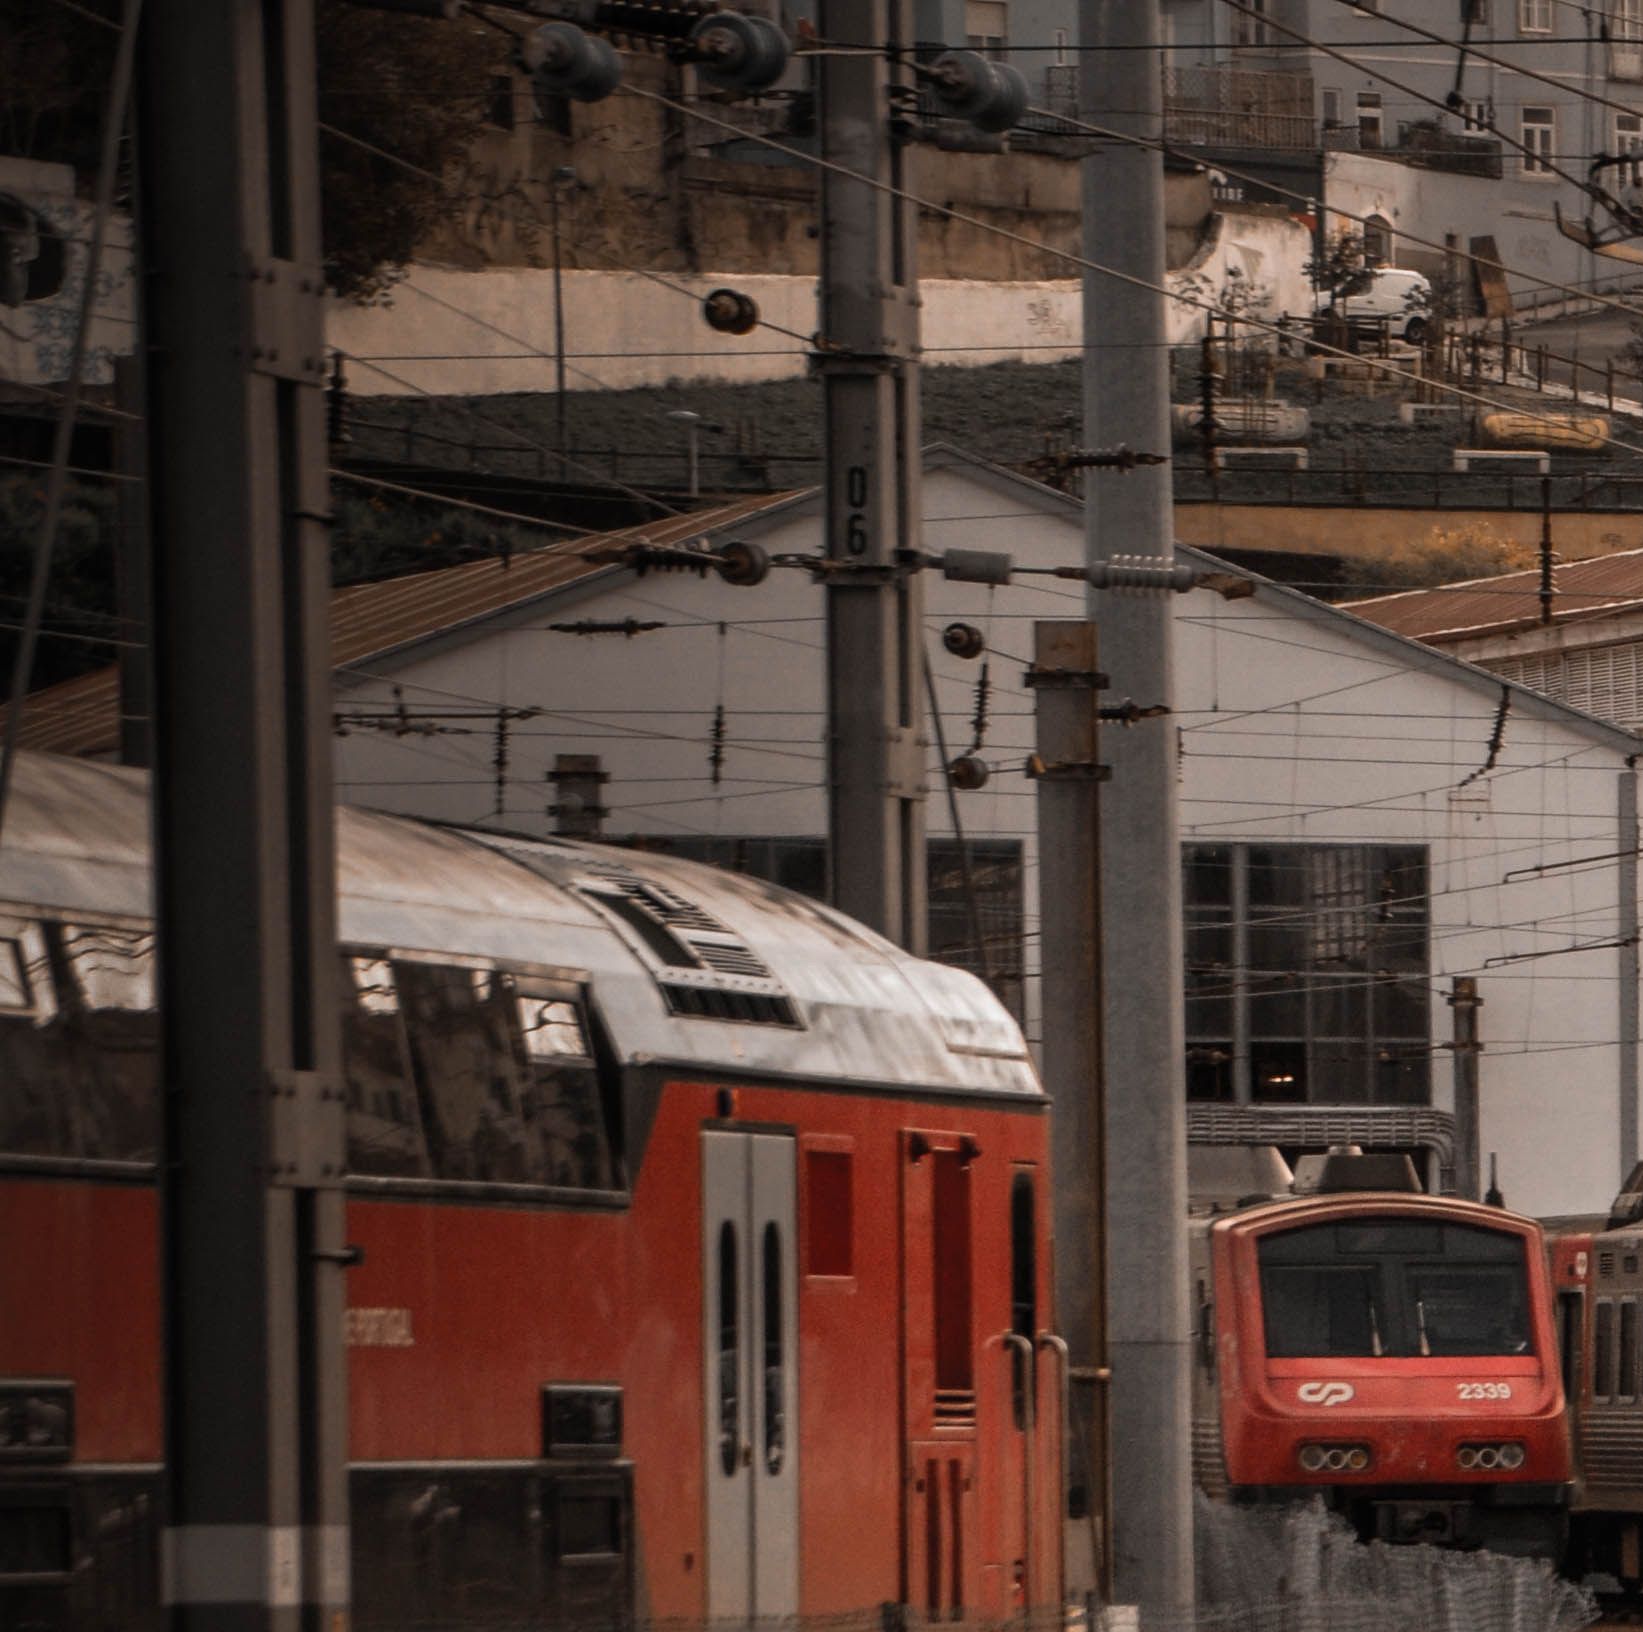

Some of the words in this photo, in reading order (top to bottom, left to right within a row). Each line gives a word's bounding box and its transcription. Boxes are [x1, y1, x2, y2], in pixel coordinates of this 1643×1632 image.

[848, 466, 865, 555] 06
[1298, 1382, 1354, 1406] CP
[1456, 1382, 1511, 1400] 2339
